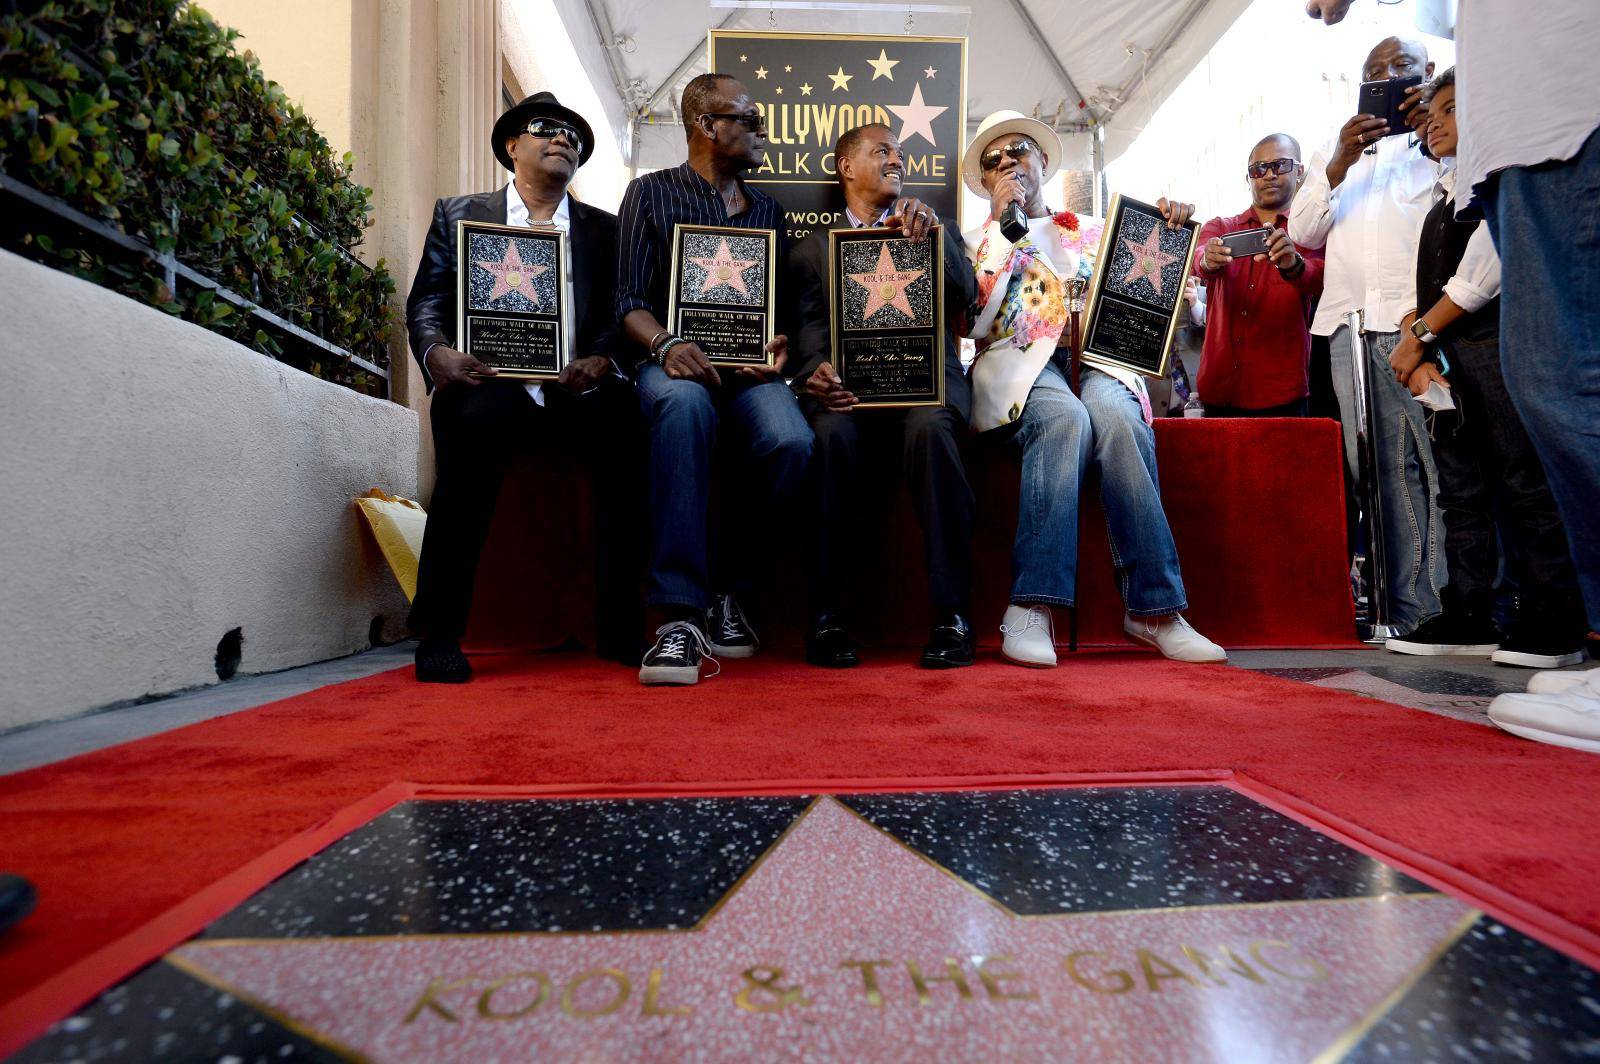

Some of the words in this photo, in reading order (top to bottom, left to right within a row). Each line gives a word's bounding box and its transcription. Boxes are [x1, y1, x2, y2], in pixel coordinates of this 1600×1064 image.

[747, 151, 811, 174] ALK
[402, 967, 693, 1024] KOOL
[733, 965, 812, 1013] &
[840, 953, 1042, 1004] THE
[1065, 939, 1330, 996] GANG
